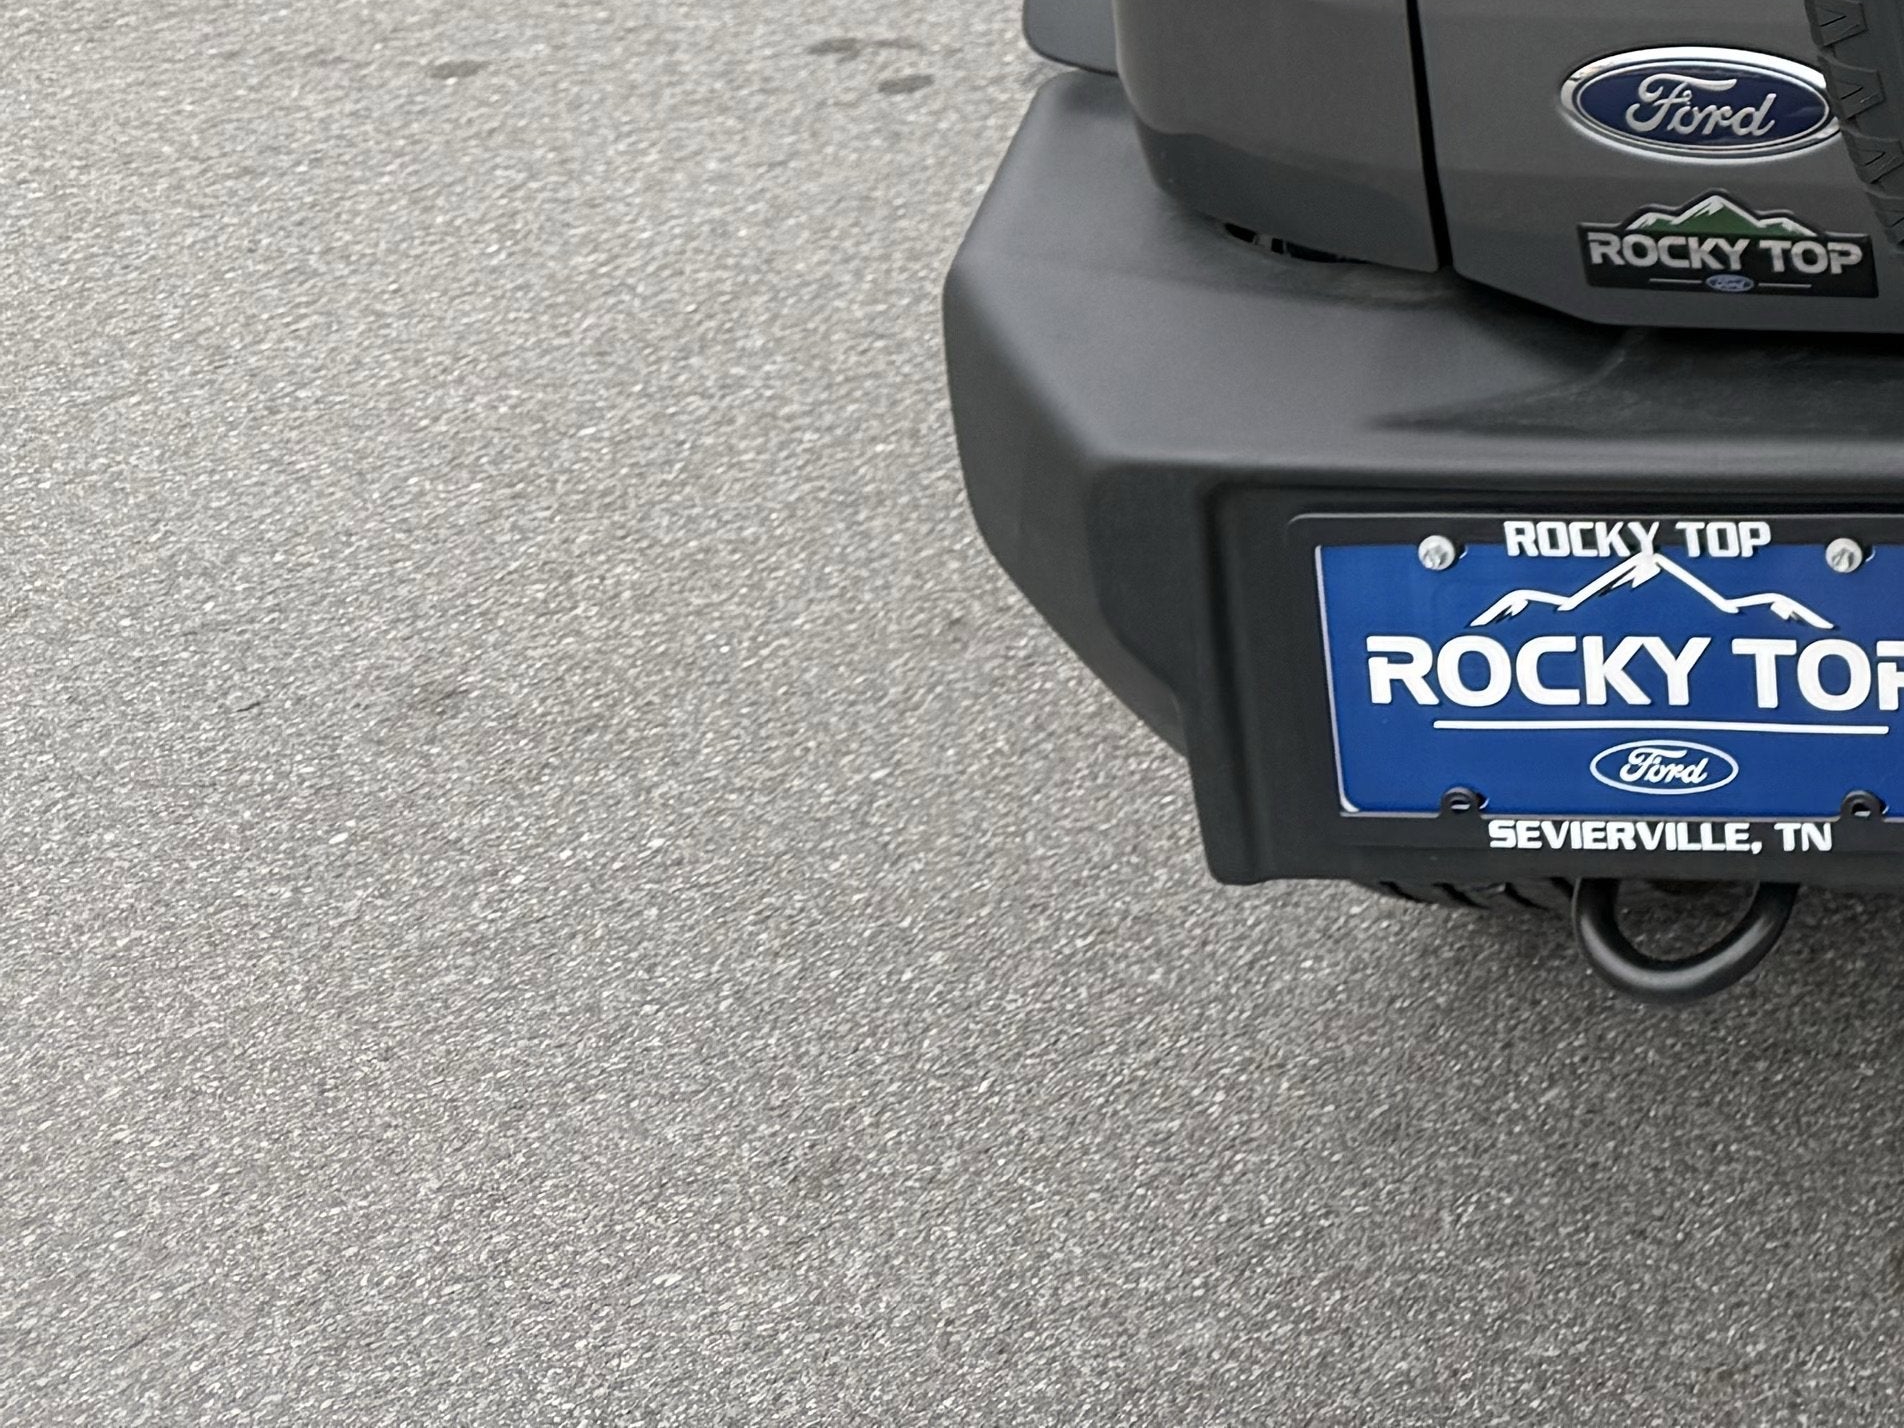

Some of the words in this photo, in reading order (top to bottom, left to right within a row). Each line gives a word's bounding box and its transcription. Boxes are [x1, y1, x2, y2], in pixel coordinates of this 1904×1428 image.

[1626, 73, 1777, 136] Ford
[1587, 232, 1750, 270] ROCKY
[1759, 242, 1863, 275] TOP
[1503, 521, 1659, 557] ROCKY
[1676, 522, 1771, 558] TOP
[1367, 636, 1711, 706] ROCKY
[1620, 748, 1709, 784] Ford
[1490, 820, 1762, 854] SEVIERVILLE,
[1775, 823, 1833, 852] TN
